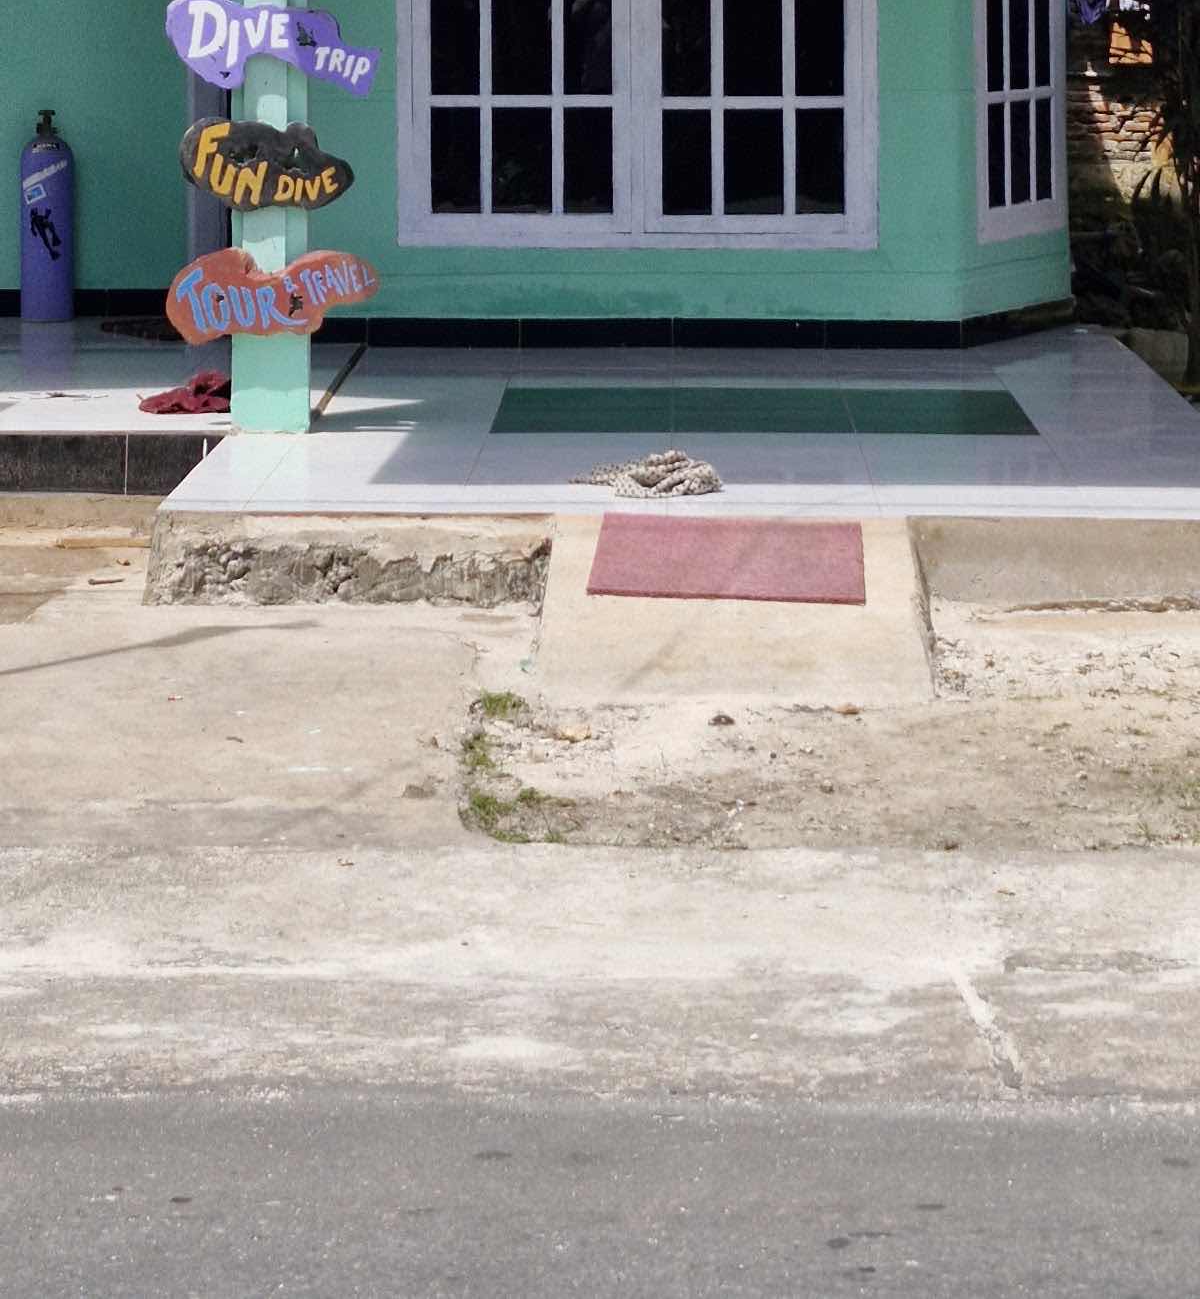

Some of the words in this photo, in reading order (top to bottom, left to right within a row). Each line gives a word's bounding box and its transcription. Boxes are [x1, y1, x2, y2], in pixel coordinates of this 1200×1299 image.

[187, 0, 291, 68] DIVE
[314, 46, 372, 85] TRIP
[193, 122, 269, 205] FUN
[274, 166, 339, 203] DIVE
[175, 266, 308, 335] TOUR
[300, 260, 376, 306] TRAVEL
